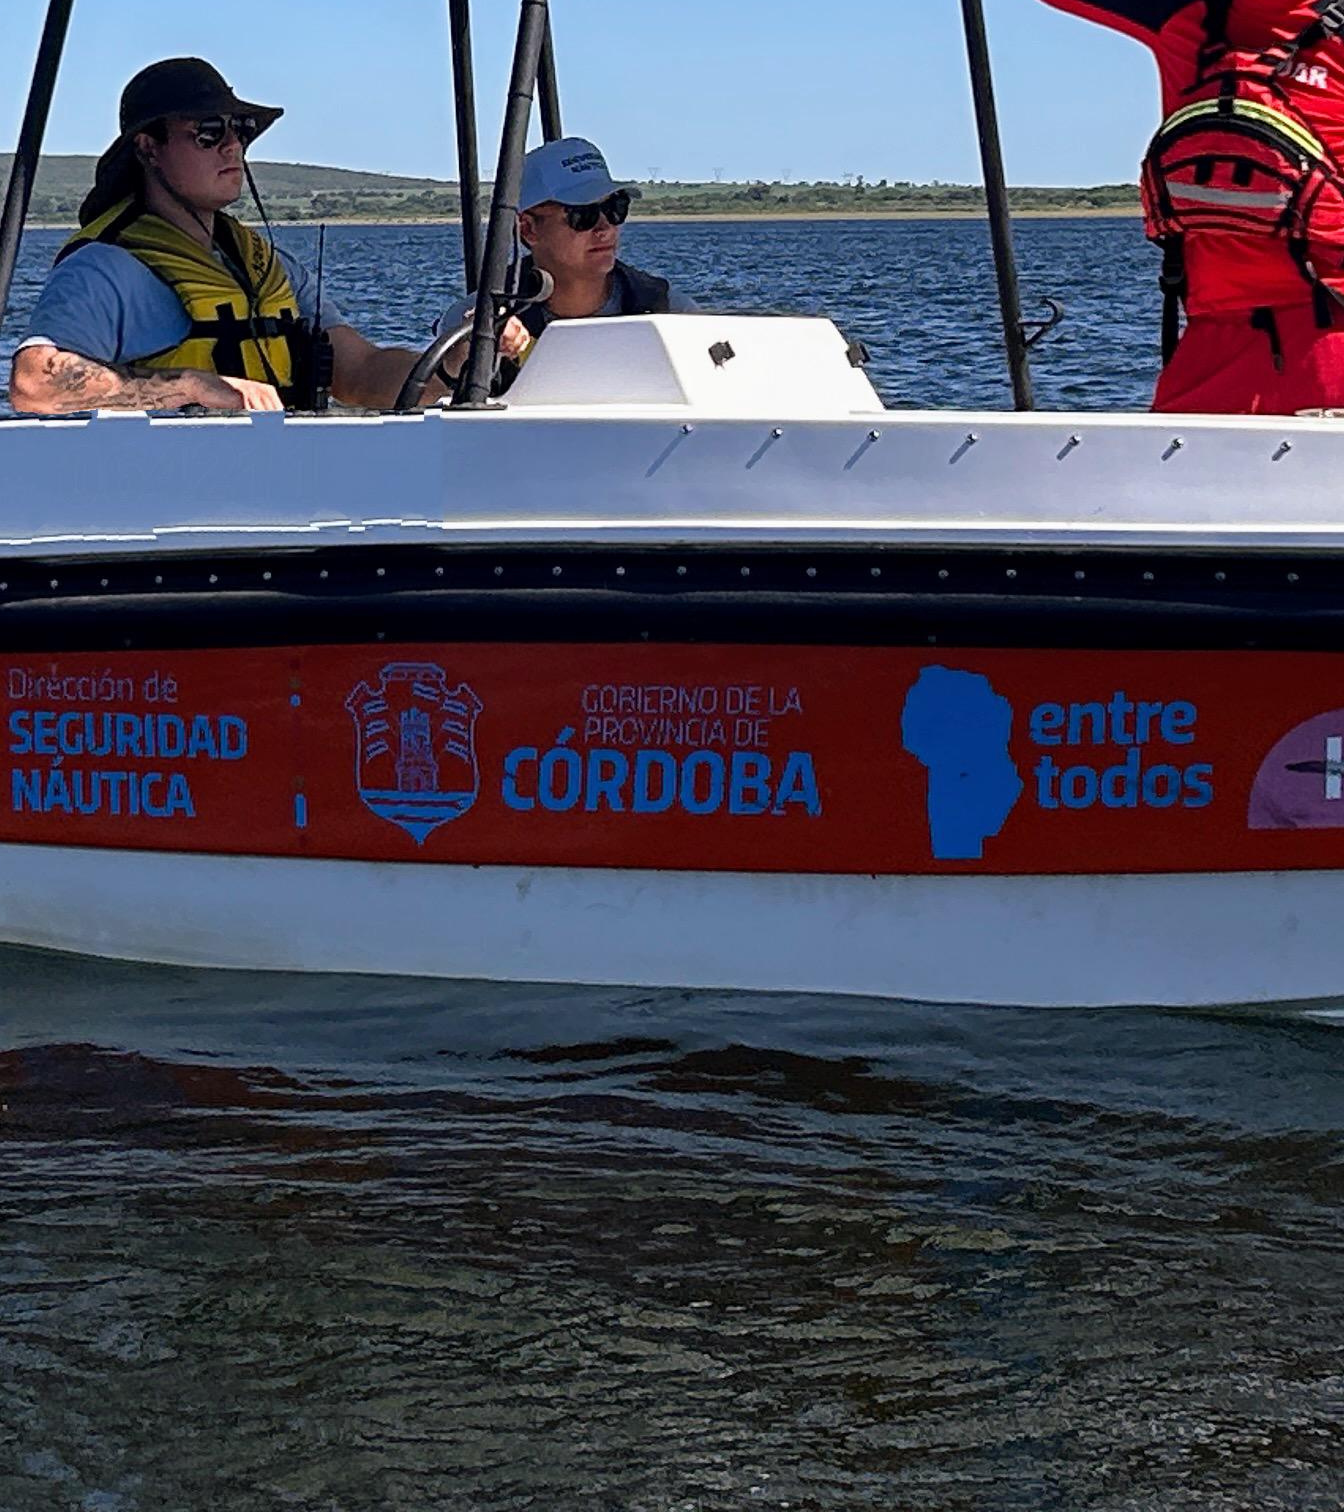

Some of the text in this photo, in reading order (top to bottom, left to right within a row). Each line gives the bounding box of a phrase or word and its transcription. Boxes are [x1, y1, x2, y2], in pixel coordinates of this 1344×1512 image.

[8, 667, 178, 702] Dirección de
[581, 685, 803, 715] GOBIERNO DE LA
[9, 710, 249, 761] SEGURIDAD
[582, 717, 771, 746] PROVINCIA DE
[1030, 689, 1198, 746] entre
[11, 755, 197, 818] NÁUTICA
[501, 725, 823, 817] CÓRDOBA
[1033, 746, 1214, 810] todos
